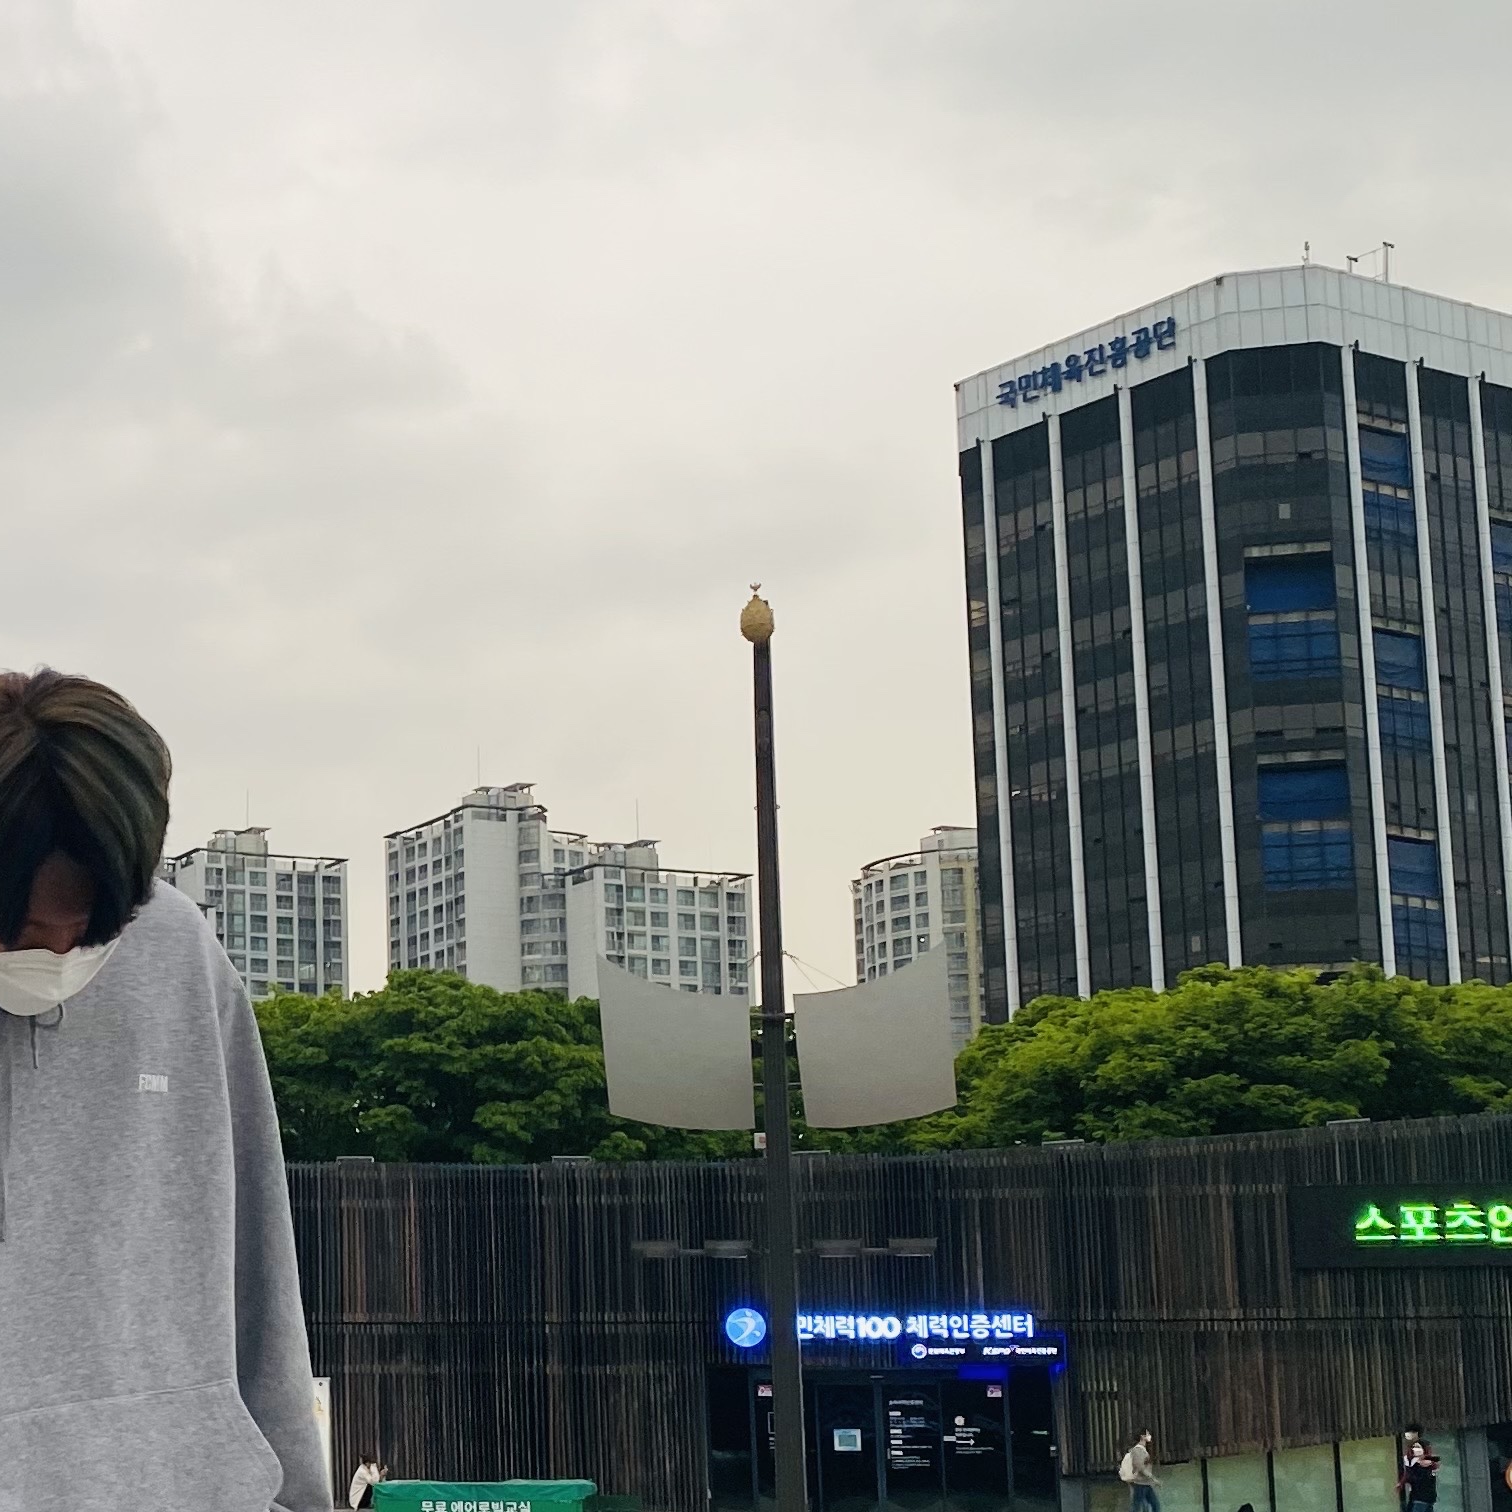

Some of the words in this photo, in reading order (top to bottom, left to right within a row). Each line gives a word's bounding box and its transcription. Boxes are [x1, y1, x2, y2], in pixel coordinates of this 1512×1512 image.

[996, 316, 1176, 409] 국민체육진흥공단
[797, 1315, 902, 1340] 민체력100
[906, 1313, 1034, 1340] 체력인증센터
